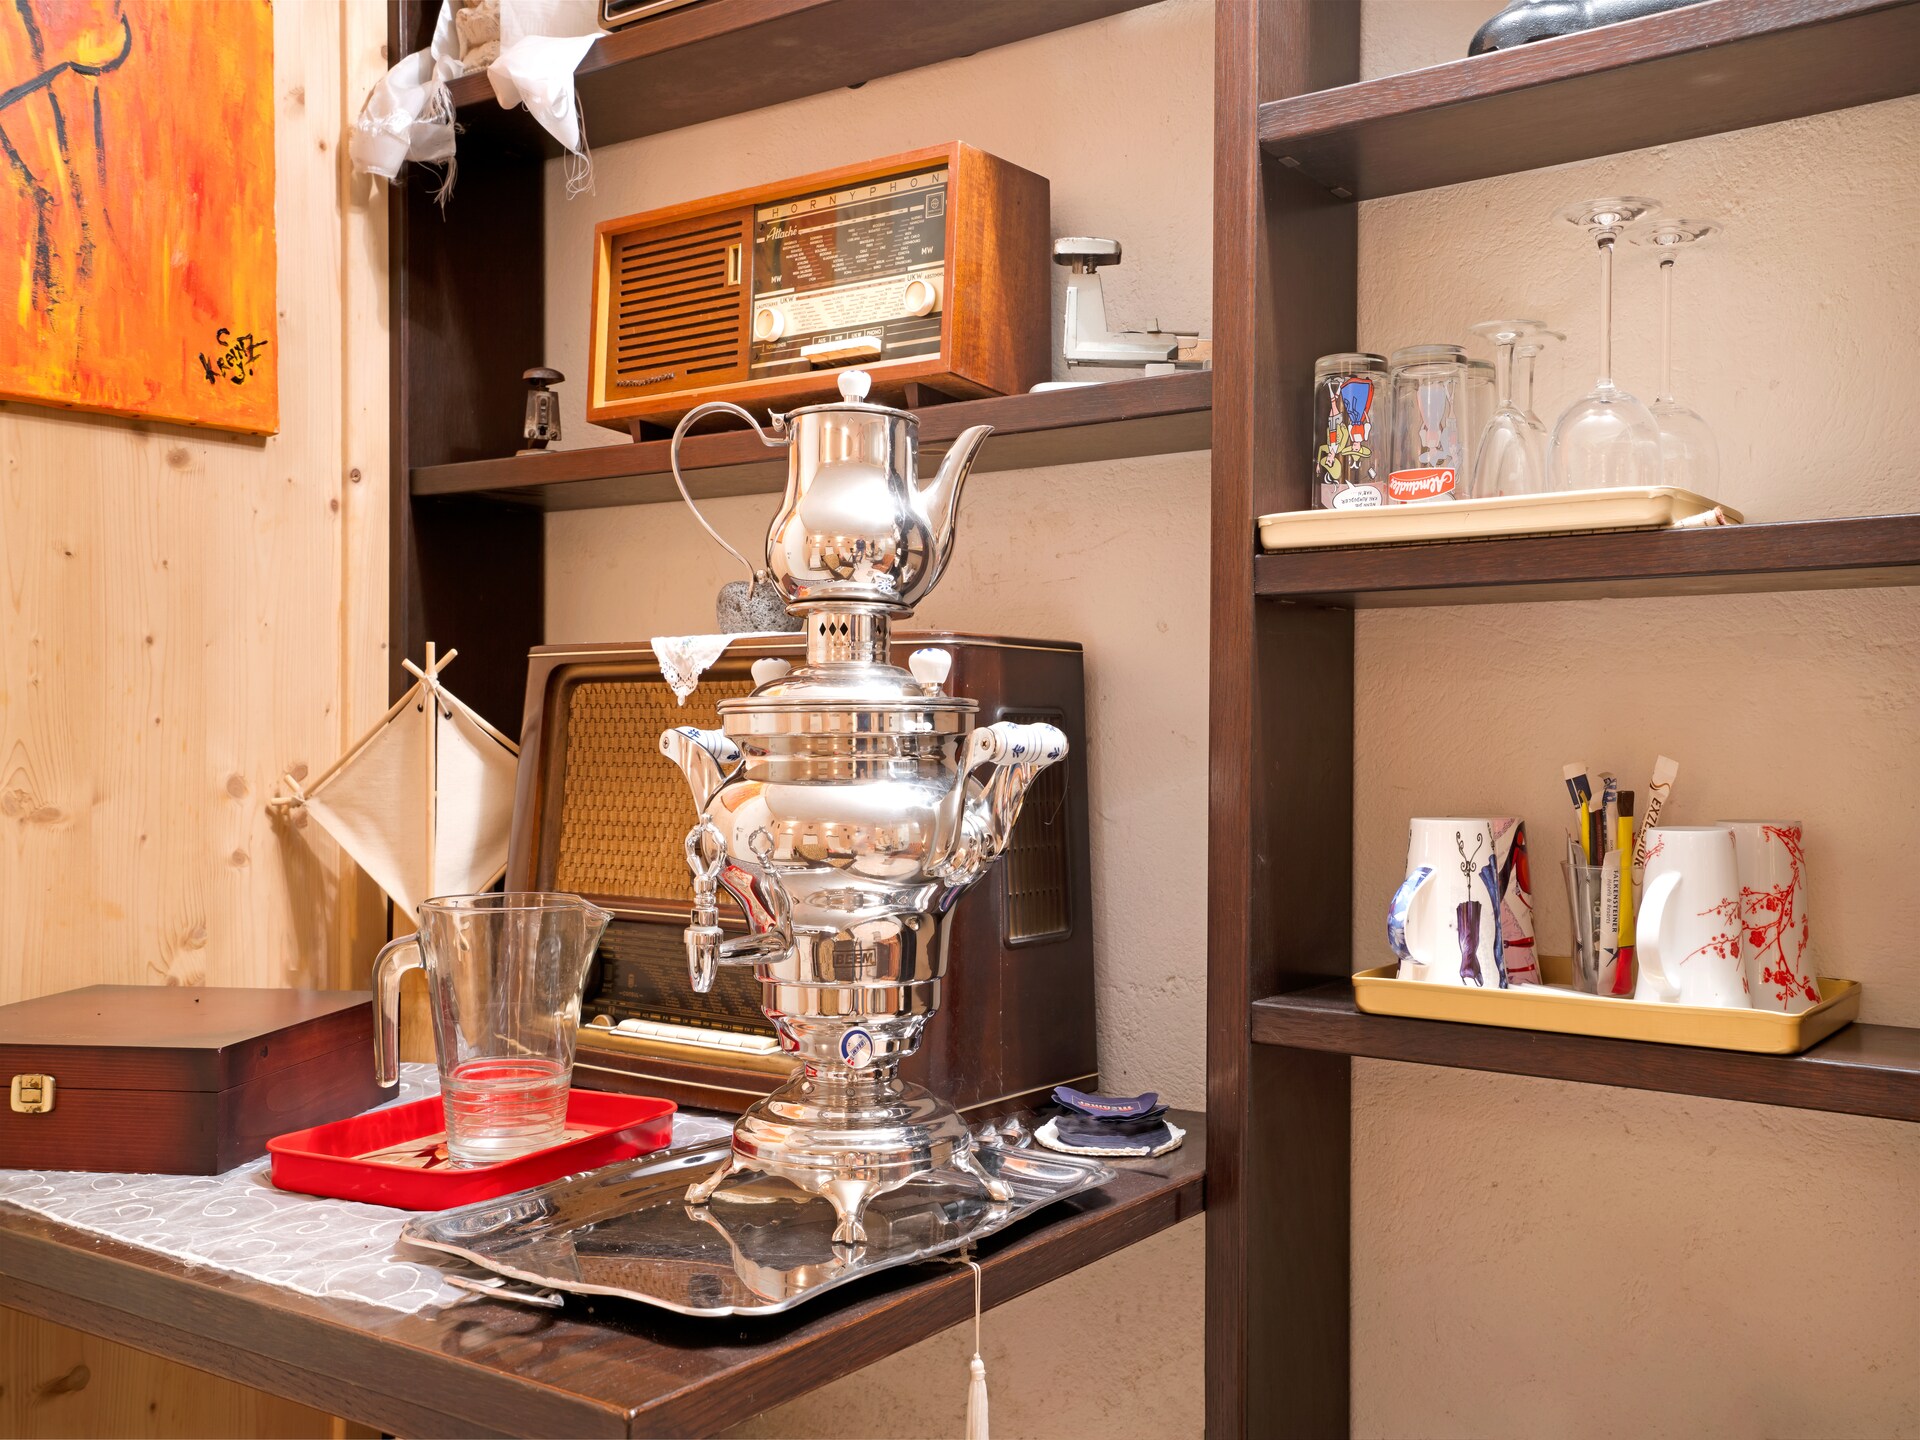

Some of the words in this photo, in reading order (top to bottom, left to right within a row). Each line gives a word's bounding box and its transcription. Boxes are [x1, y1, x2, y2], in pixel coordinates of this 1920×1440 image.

[772, 174, 940, 217] HORNYPHON
[766, 225, 798, 241] Attaché
[921, 246, 934, 255] MW
[771, 275, 782, 283] MW
[907, 273, 922, 281] UKW
[780, 296, 794, 304] UKW
[1390, 470, 1453, 496] Almdudler
